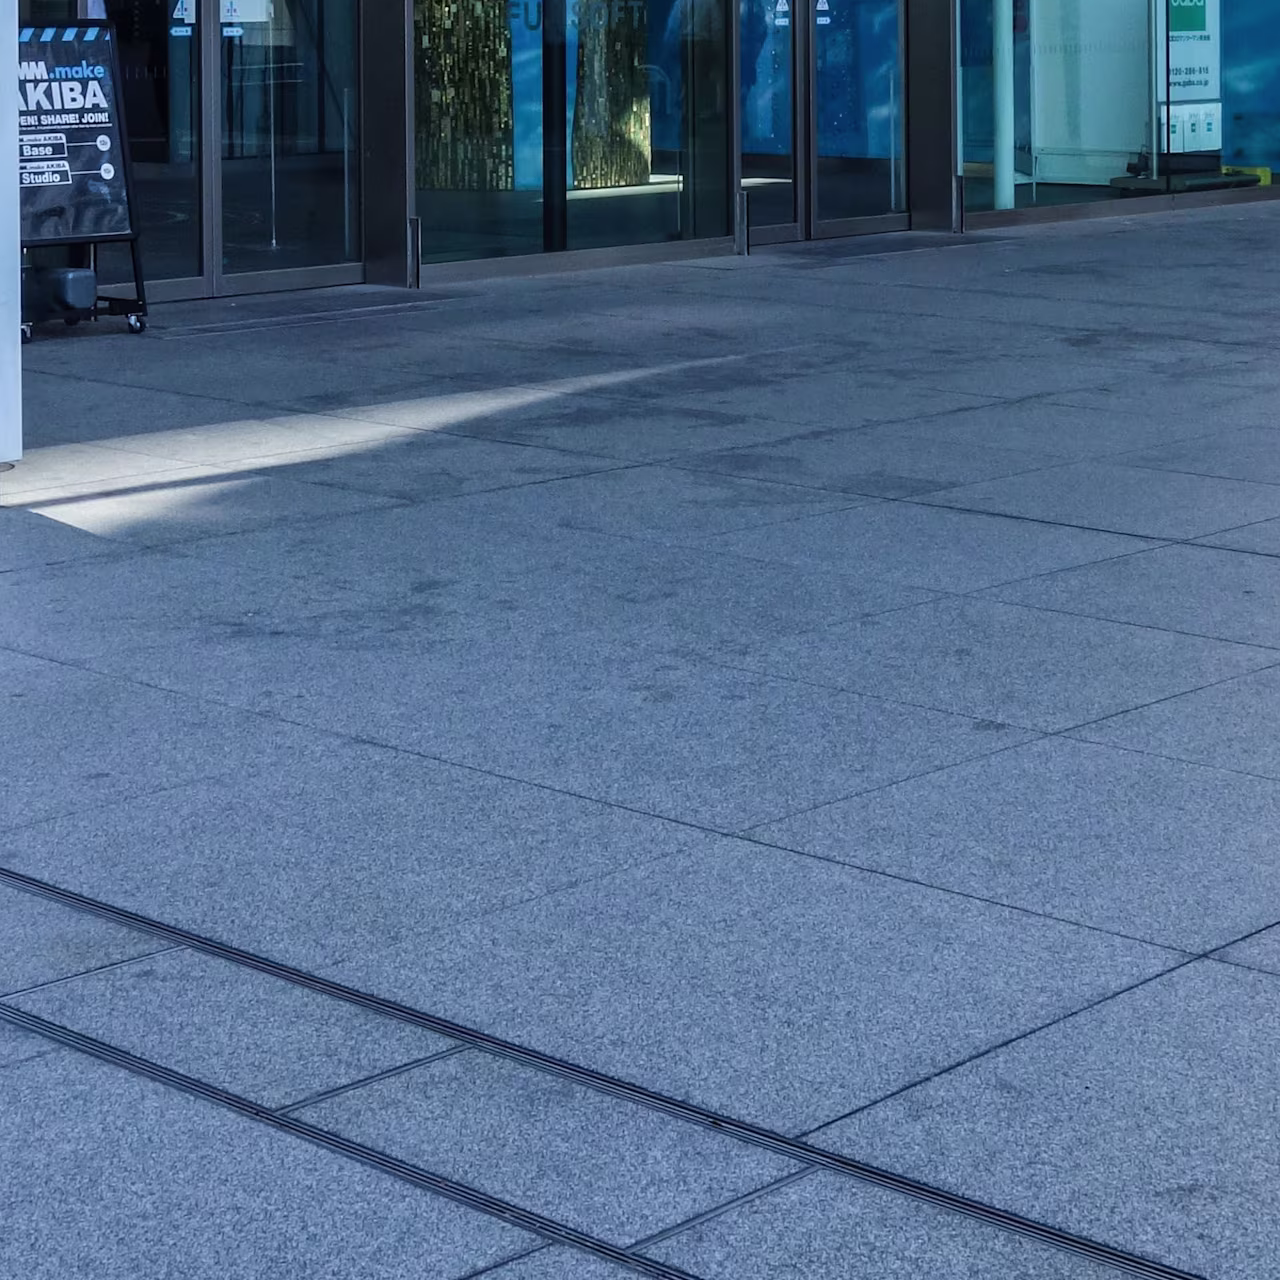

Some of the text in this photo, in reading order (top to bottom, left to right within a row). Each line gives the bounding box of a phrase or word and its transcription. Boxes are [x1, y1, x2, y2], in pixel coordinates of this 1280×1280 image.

[18, 60, 105, 80] MM.make
[18, 112, 109, 126] EN! SHARE! JOIN!
[22, 144, 53, 156] Base
[21, 171, 61, 184] Studio
